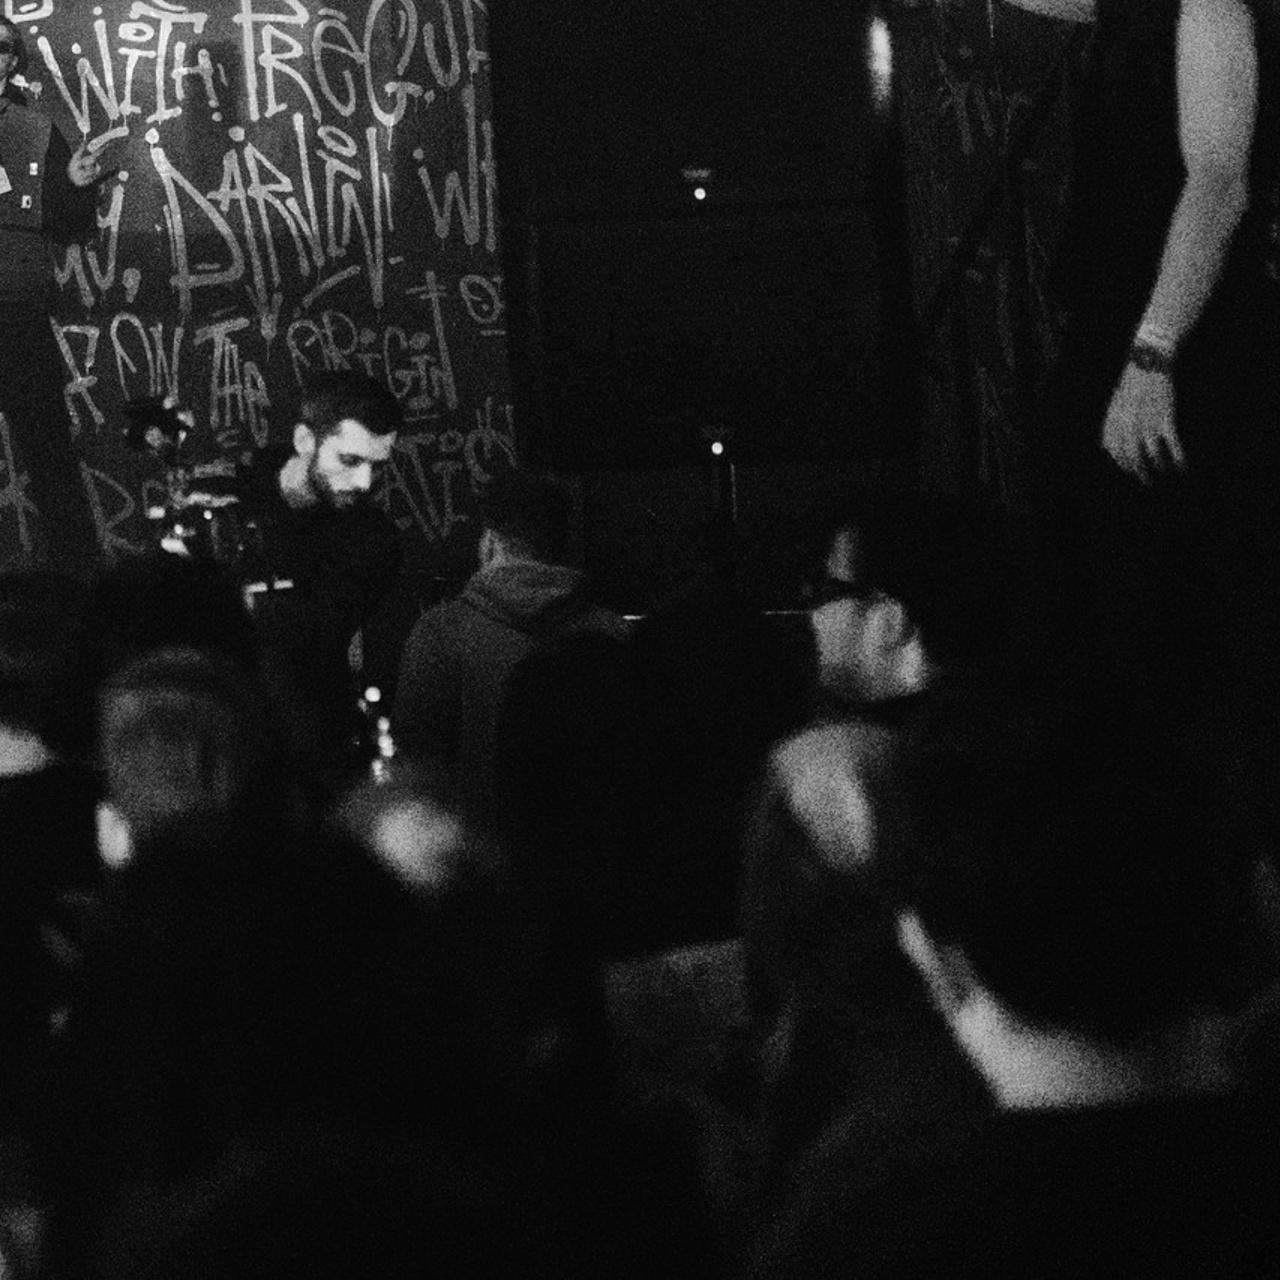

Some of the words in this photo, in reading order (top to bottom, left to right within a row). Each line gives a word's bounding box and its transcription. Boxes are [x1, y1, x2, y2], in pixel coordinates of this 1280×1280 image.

[35, 0, 223, 145] WITH
[148, 113, 388, 342] DARWIN
[192, 315, 272, 450] THE
